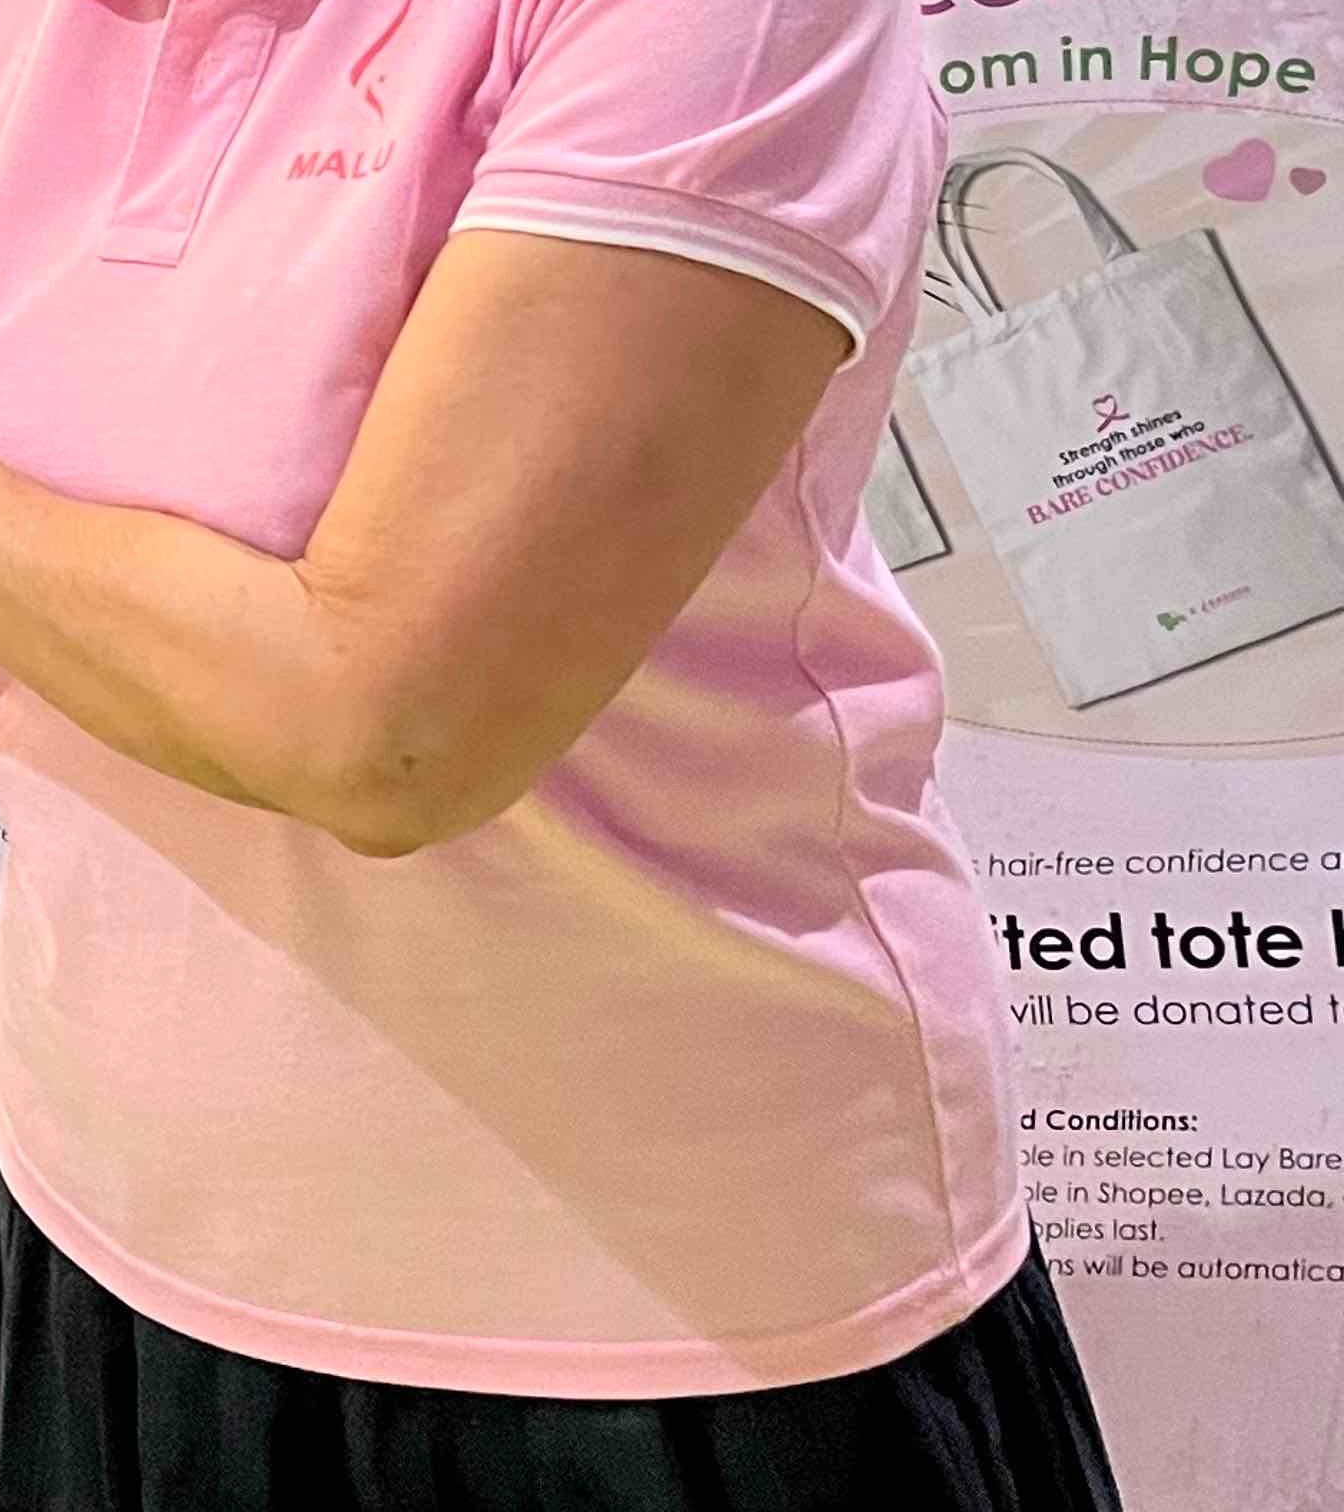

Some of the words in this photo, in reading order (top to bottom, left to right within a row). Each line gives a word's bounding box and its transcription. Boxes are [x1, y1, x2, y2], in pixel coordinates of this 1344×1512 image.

[1061, 36, 1113, 82] in
[1140, 35, 1316, 97] Hope
[287, 140, 395, 181] MALU
[1059, 430, 1128, 465] Strength
[1130, 409, 1182, 437] shines
[1053, 454, 1117, 489] through
[1120, 437, 1165, 462] those
[1169, 420, 1205, 442] who
[1027, 485, 1093, 525] BARE
[989, 850, 1114, 876] hair-free
[1126, 848, 1308, 874] confidence
[1151, 910, 1303, 969] tote
[1066, 995, 1119, 1025] be
[1134, 993, 1312, 1025] donated
[1046, 1109, 1198, 1132] Conditions:
[1063, 1145, 1085, 1167] in
[1093, 1146, 1212, 1169] selected
[1222, 1148, 1270, 1174] Lay
[1279, 1148, 1342, 1170] Bare
[1067, 1181, 1088, 1204] in
[1097, 1181, 1210, 1209] Shopee,
[1221, 1183, 1334, 1209] Lazada,
[1113, 1218, 1165, 1241] last.
[1083, 1254, 1123, 1276] will
[1132, 1256, 1168, 1278] be
